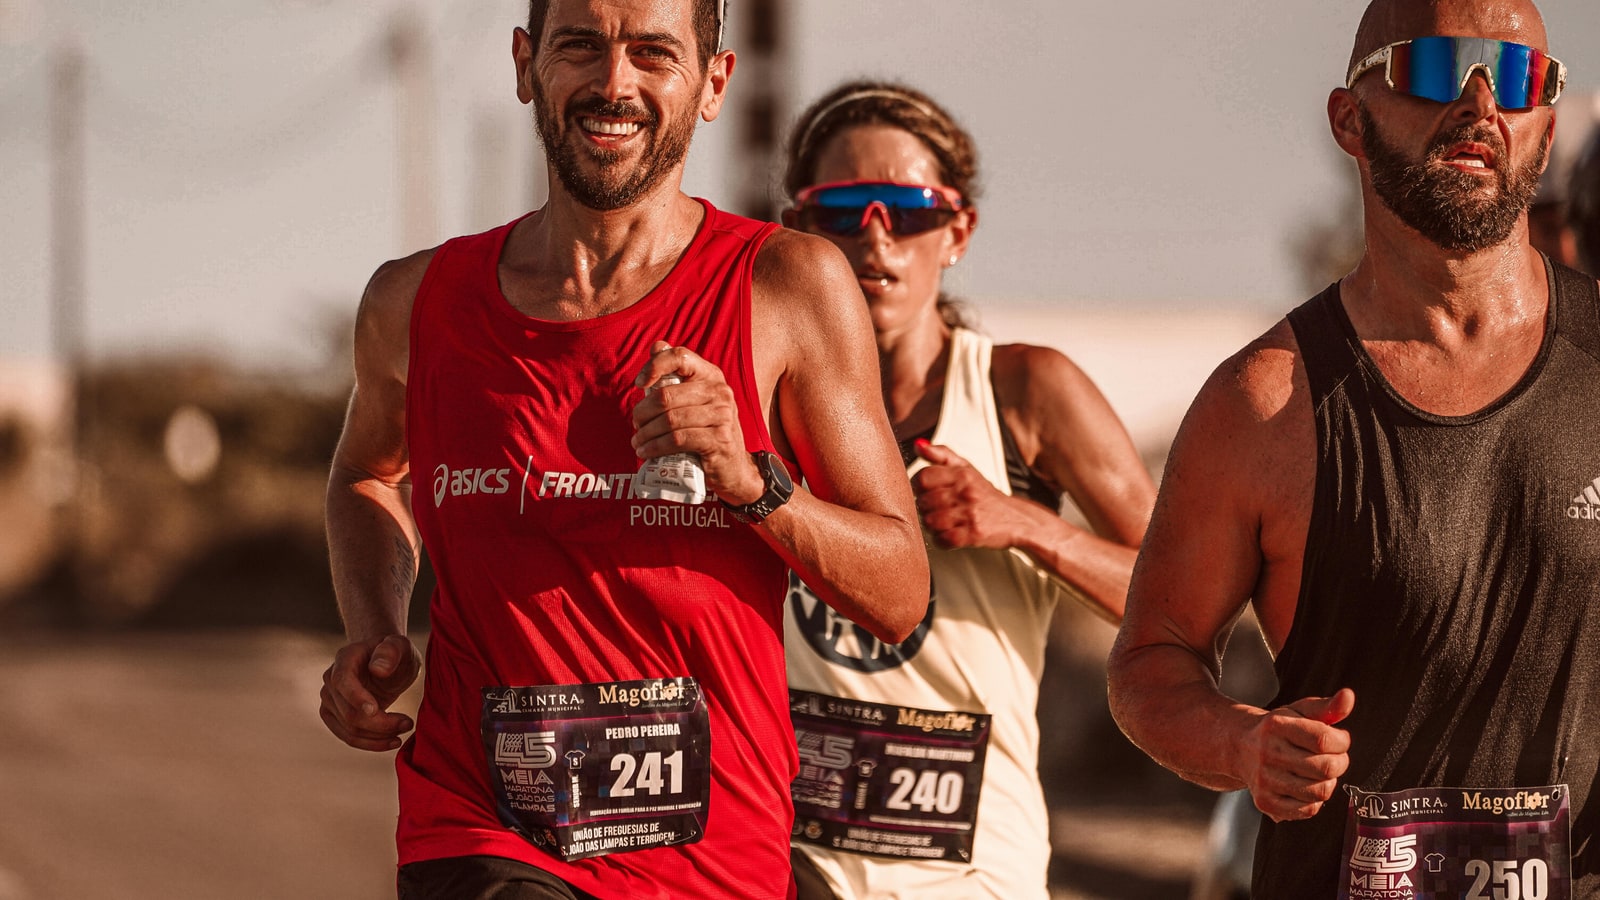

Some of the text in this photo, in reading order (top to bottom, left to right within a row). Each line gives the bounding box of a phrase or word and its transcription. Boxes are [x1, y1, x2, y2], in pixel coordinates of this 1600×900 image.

[630, 505, 730, 528] PORTUGAL
[521, 693, 580, 706] SINTRA
[598, 682, 685, 707] Magoflor
[547, 705, 581, 713] MUNICIPAL
[827, 701, 883, 720] SINTRA
[605, 723, 681, 740] PEDRO PEREIRA
[573, 757, 578, 766] S
[500, 769, 554, 785] MEIA
[610, 750, 683, 798] 241
[505, 785, 554, 794] MARATONA
[534, 795, 555, 803] DAS
[886, 767, 964, 814] 240
[1391, 797, 1443, 813] SINTRA
[1462, 791, 1550, 815] Magoflor
[573, 822, 660, 841] UNIÃO DE FREGUESIAS DE
[569, 841, 584, 855] JOÃO
[585, 840, 599, 852] DAS
[600, 836, 629, 850] LAMPAS
[630, 836, 635, 846] E
[636, 831, 675, 846] TERRUGEM
[1350, 871, 1414, 890] MEIA
[1464, 858, 1548, 900] 250
[1349, 886, 1413, 898] MARATONA
